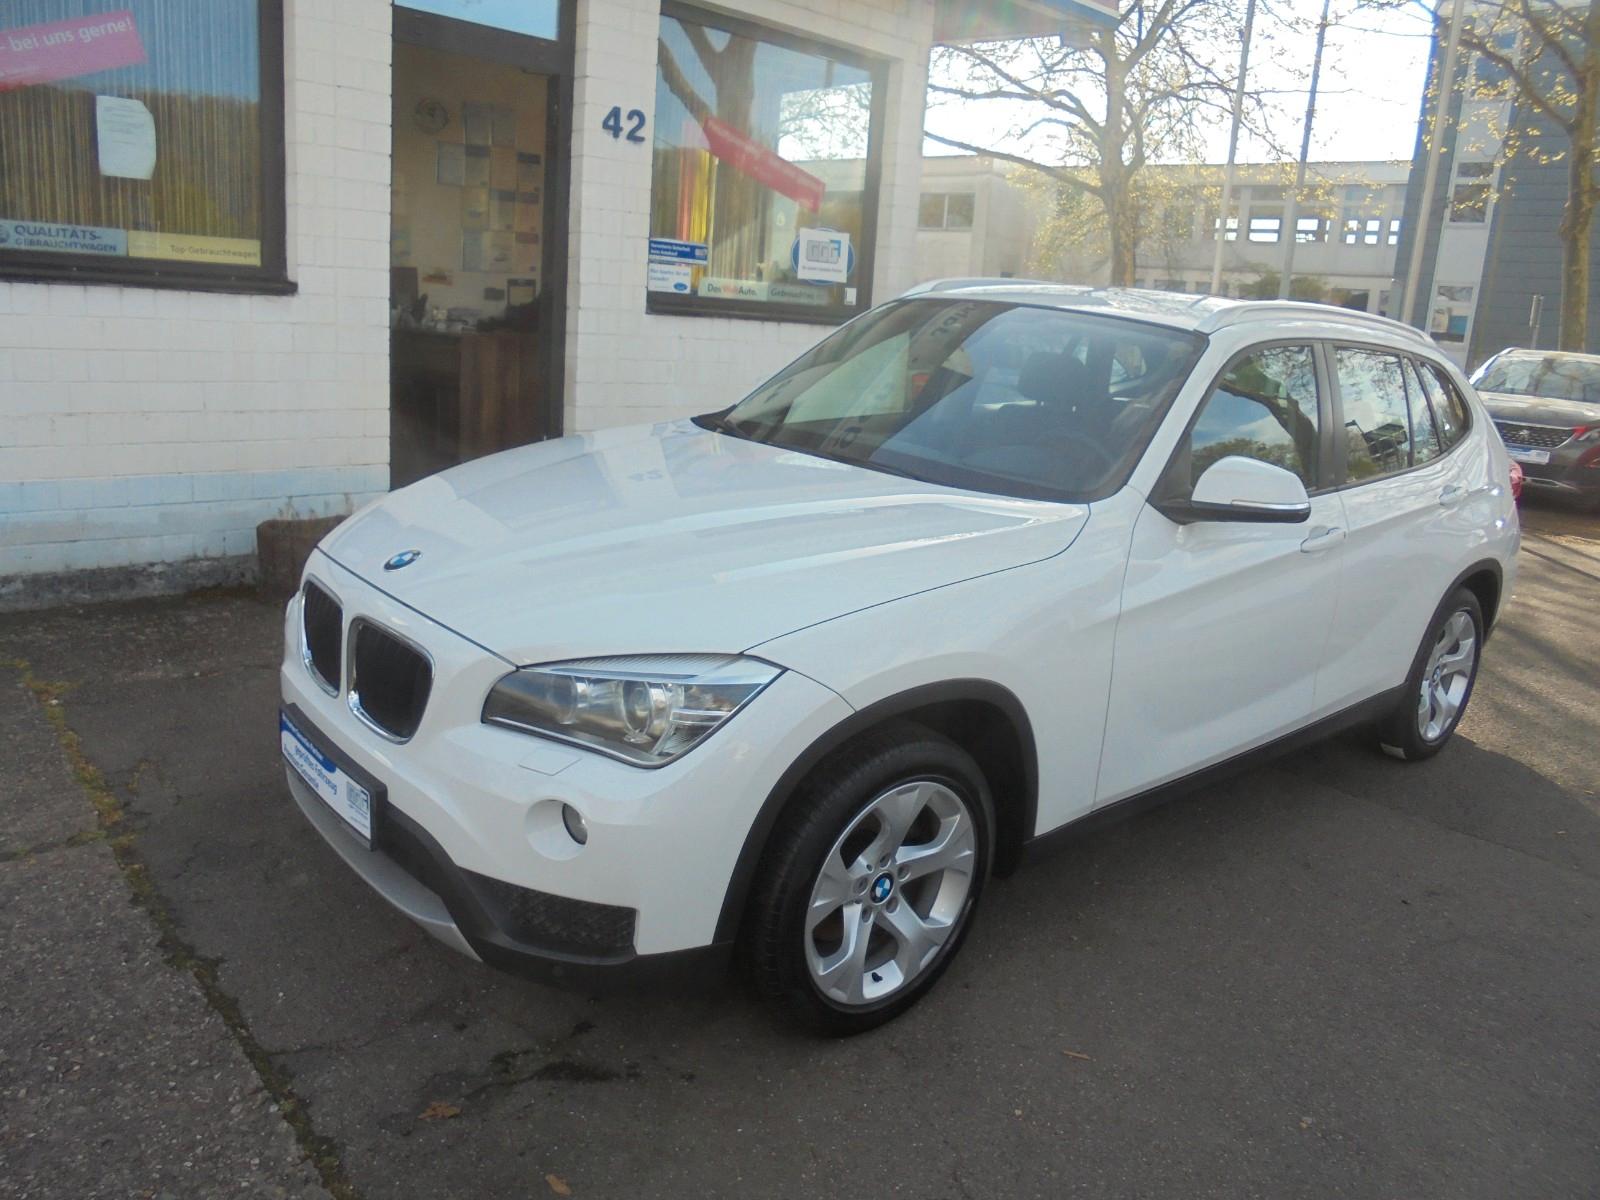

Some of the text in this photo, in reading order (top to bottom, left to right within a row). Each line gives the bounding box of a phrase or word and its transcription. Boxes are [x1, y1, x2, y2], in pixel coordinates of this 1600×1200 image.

[8, 35, 40, 52] bei
[43, 30, 75, 46] uns
[79, 17, 133, 43] gerne!
[602, 105, 646, 142] 42
